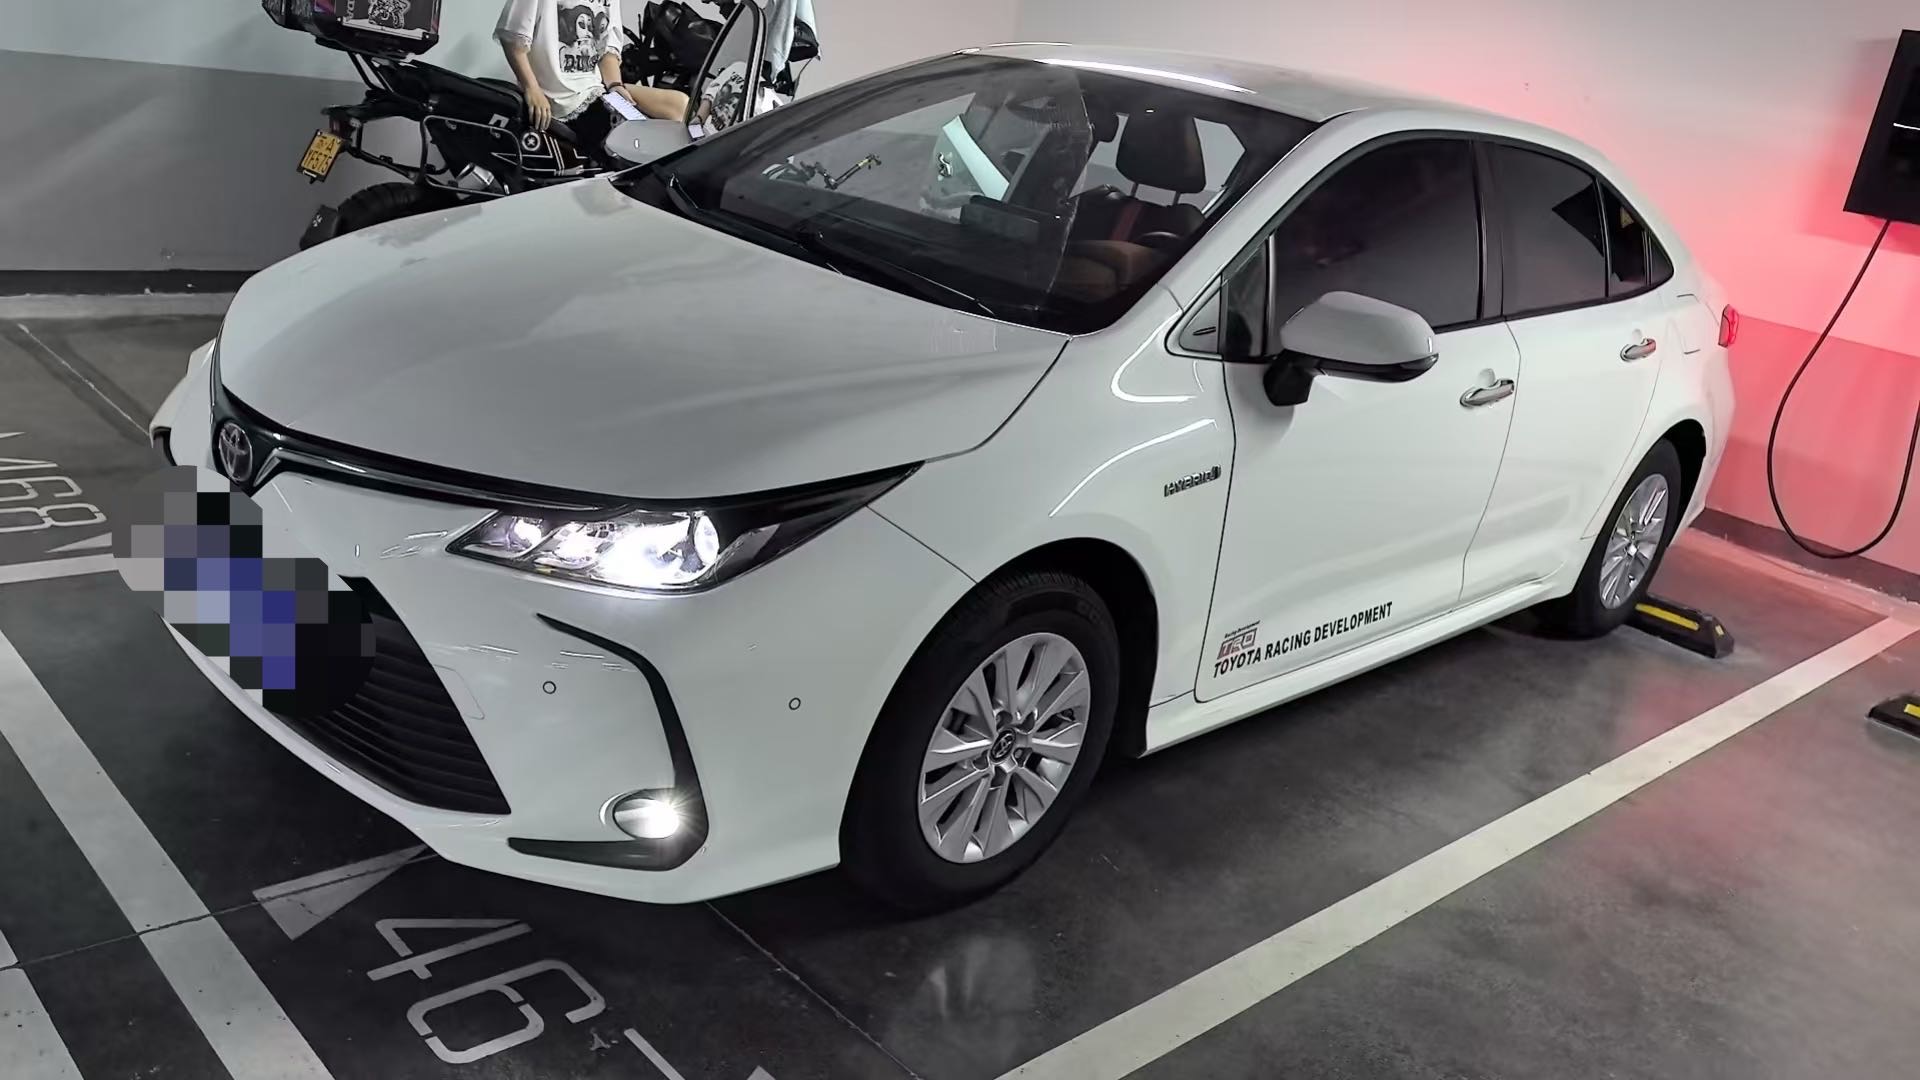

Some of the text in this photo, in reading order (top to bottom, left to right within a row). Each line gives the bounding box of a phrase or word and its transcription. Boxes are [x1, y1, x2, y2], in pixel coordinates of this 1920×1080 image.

[1213, 601, 1392, 678] TOYOTA RACING DEVELOPMENT
[367, 918, 686, 1080] 46
